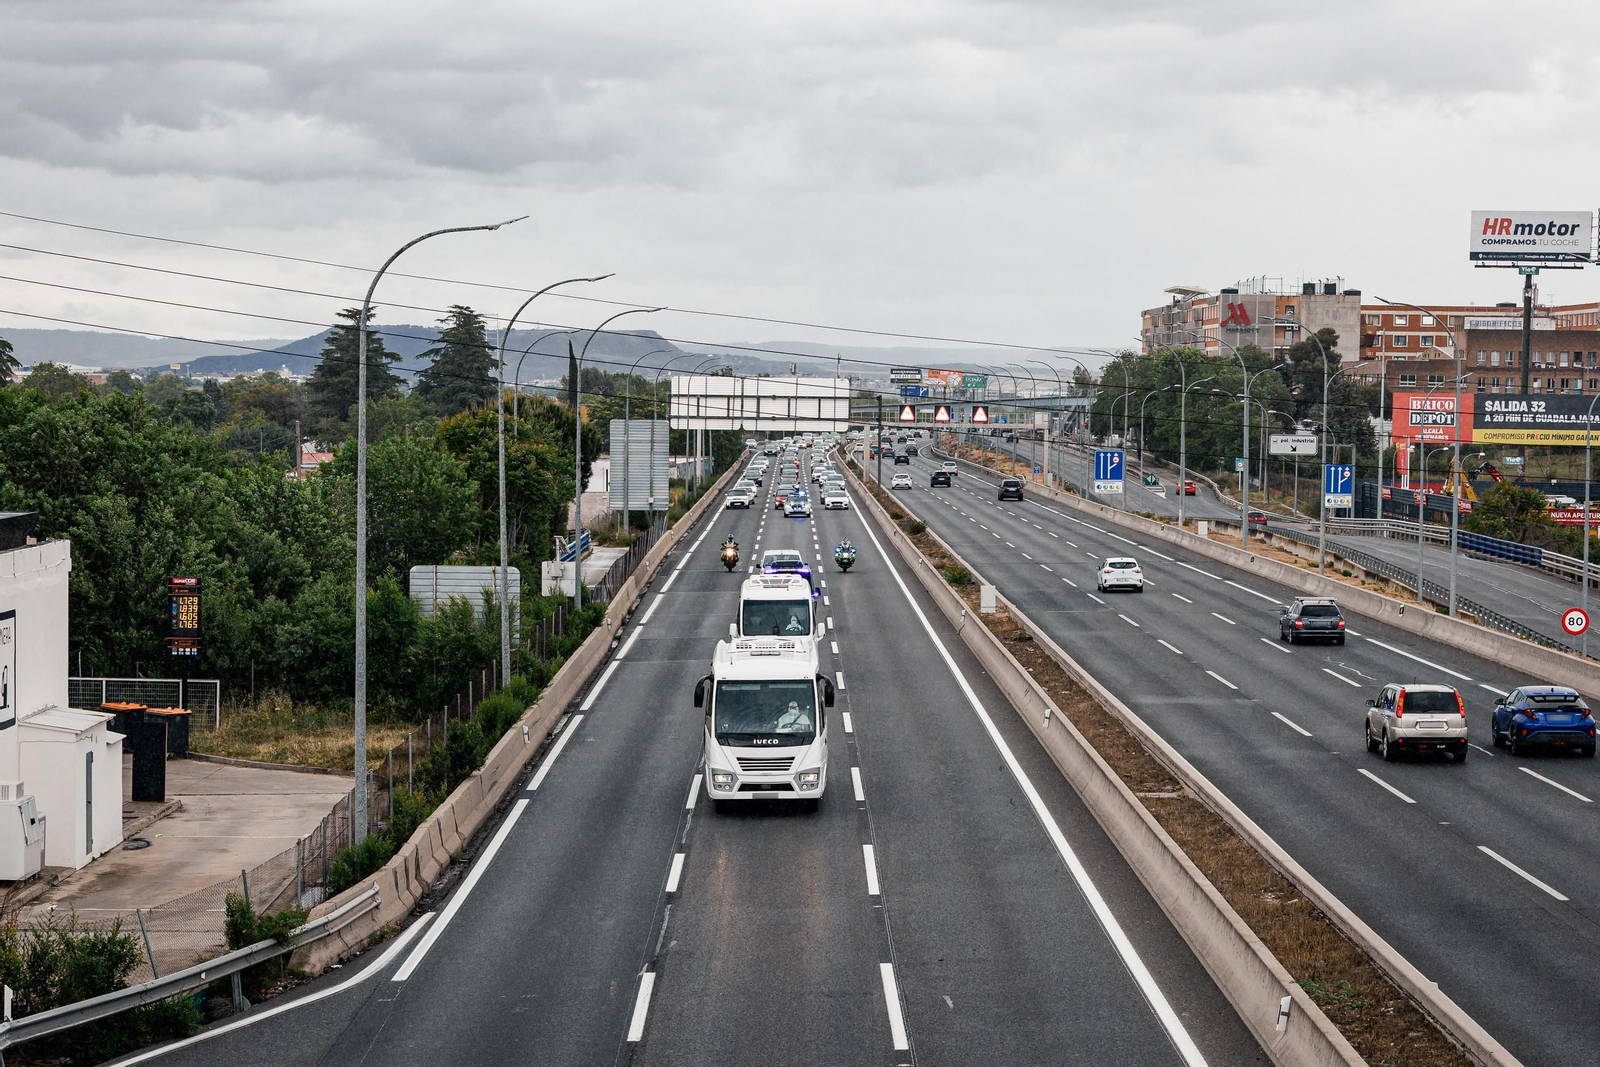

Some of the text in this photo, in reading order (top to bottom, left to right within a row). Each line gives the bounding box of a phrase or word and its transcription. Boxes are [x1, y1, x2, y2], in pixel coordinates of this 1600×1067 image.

[1481, 238, 1537, 246] COMPRAMOS
[1412, 400, 1454, 410] BRICO
[1484, 400, 1546, 412] SALIDA 32
[1484, 414, 1600, 423] A 20 MIN DE GUADALAJARA
[1483, 432, 1526, 440] COMPROMISO
[1551, 432, 1575, 441] MÍNIMO
[1568, 617, 1583, 626] 80
